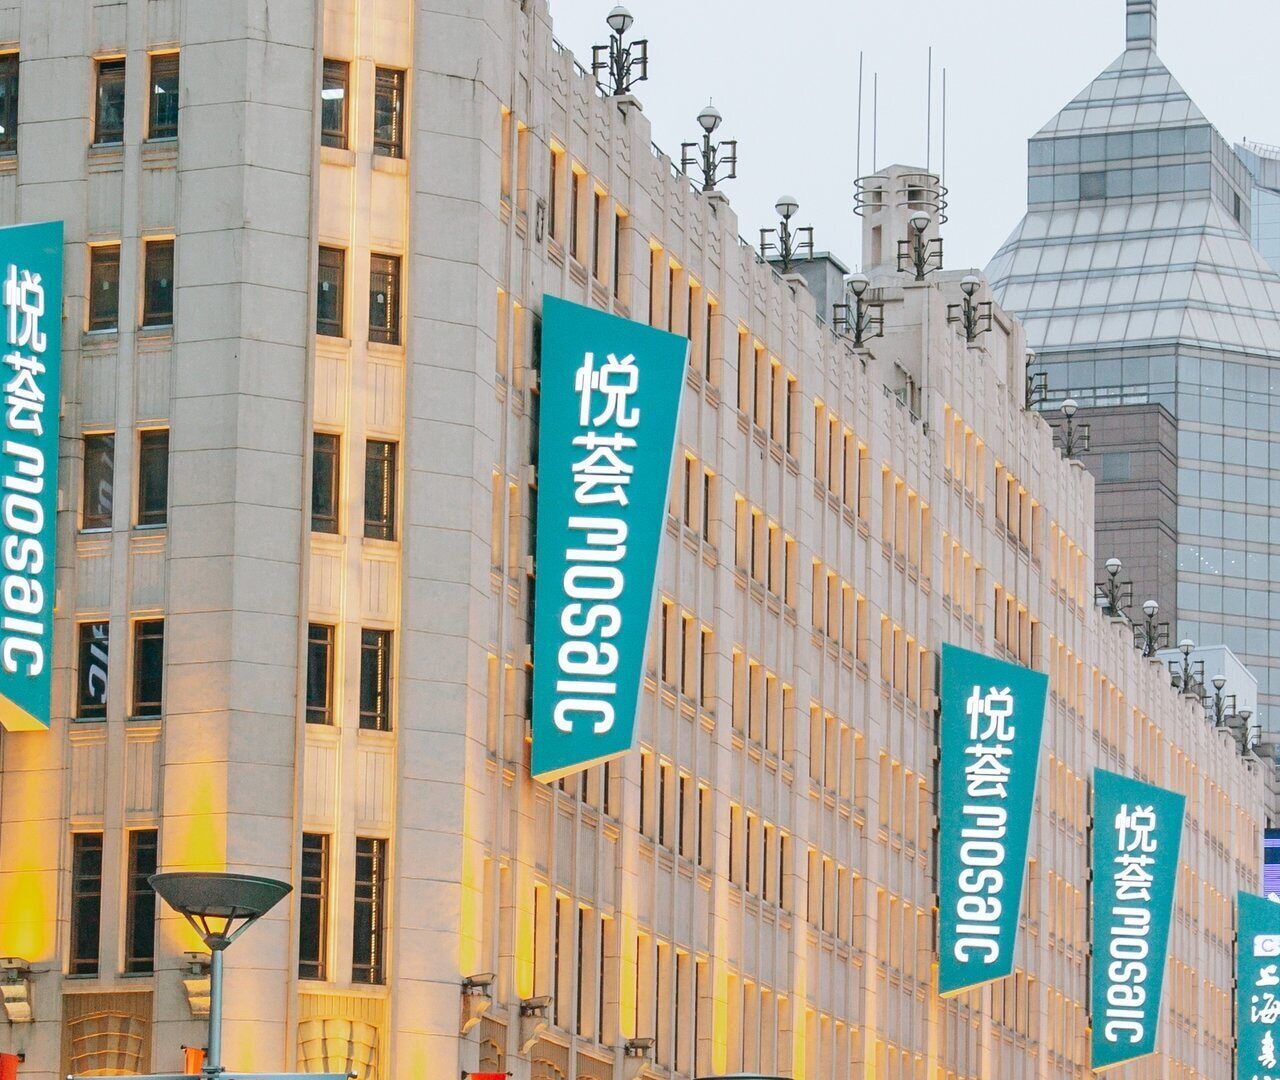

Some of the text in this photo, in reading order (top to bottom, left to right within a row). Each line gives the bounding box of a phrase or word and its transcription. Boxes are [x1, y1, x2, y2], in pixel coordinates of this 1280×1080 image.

[0, 264, 46, 677] 悦荟 mosaic
[553, 352, 640, 734] 悦荟 mosaic
[954, 685, 1015, 964] 悦荟 mosaic
[1105, 804, 1158, 1043] 悦荟 mosaic
